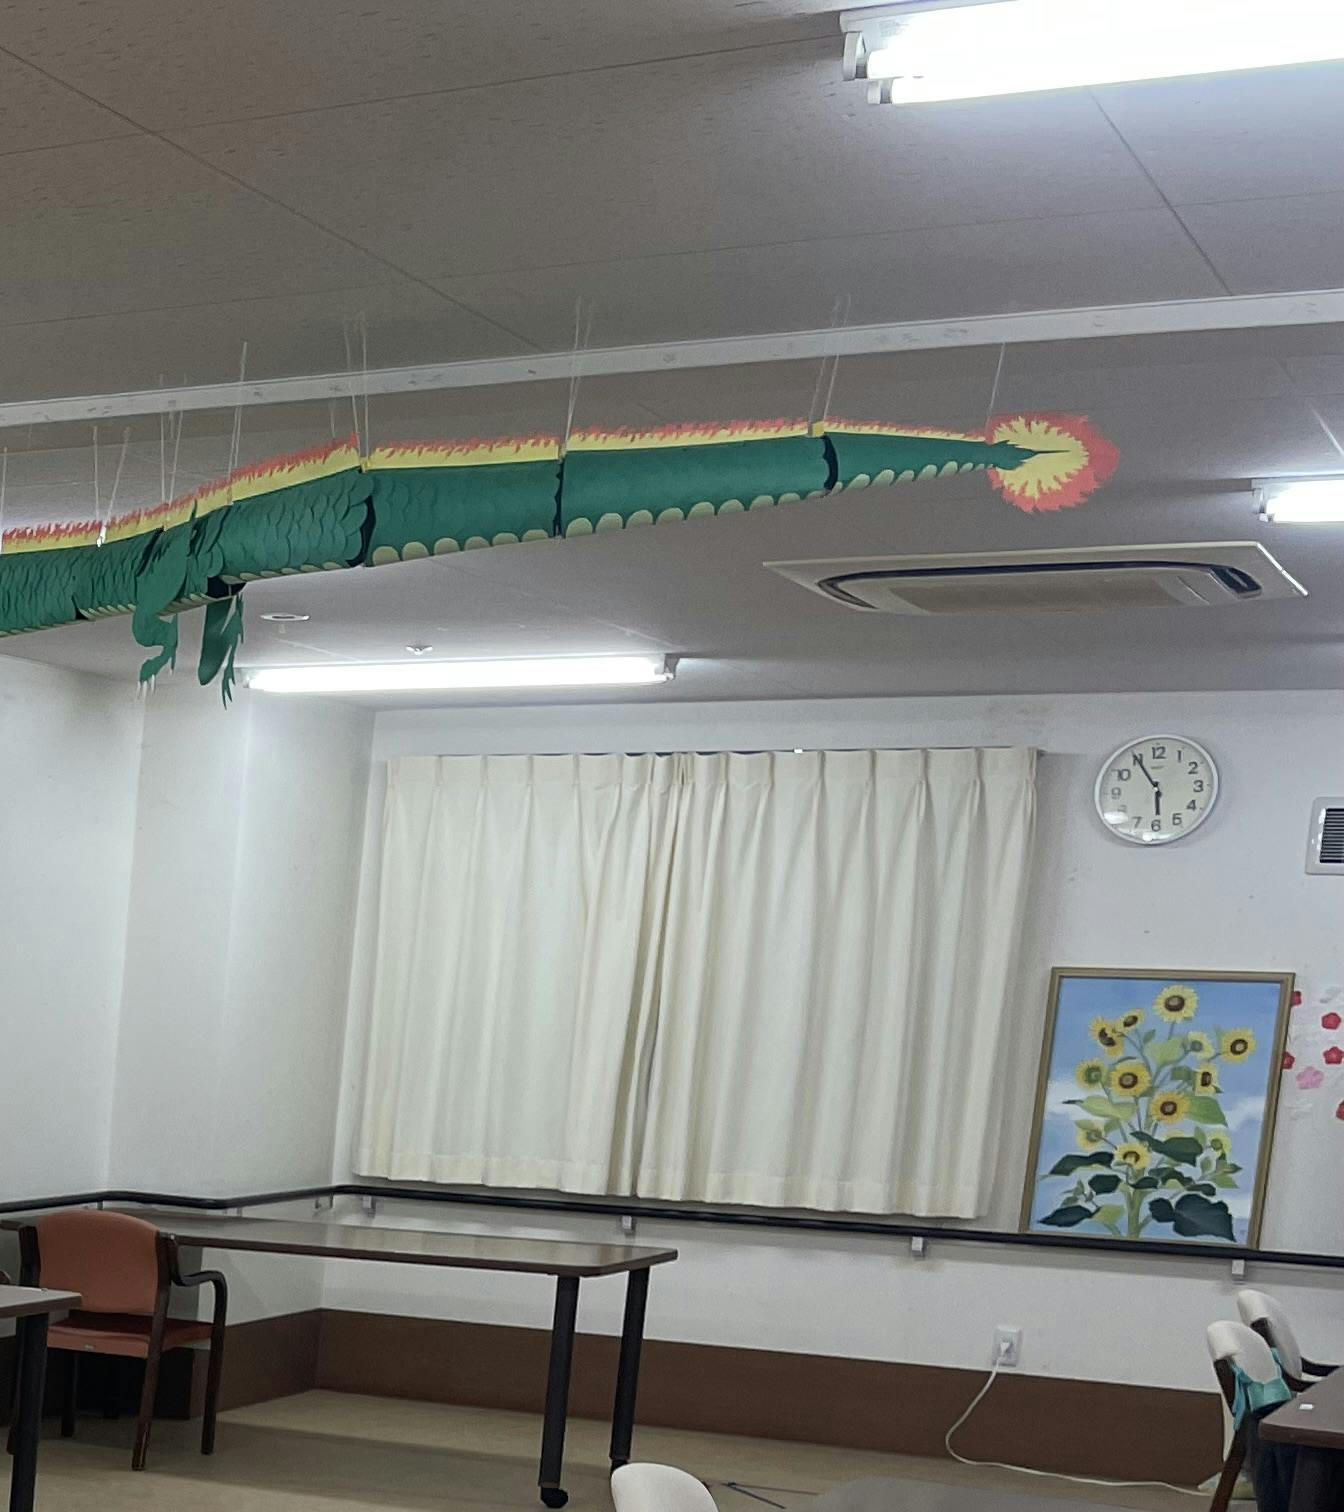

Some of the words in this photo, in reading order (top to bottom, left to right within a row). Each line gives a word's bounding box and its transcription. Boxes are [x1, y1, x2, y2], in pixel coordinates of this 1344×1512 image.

[1152, 746, 1166, 760] 12
[1177, 750, 1182, 763] 1
[1188, 762, 1198, 774] 2
[1193, 780, 1204, 792] 3
[1186, 799, 1197, 811] 4
[1132, 816, 1142, 828] 7
[1172, 813, 1182, 825] 5
[1151, 819, 1161, 832] 6
